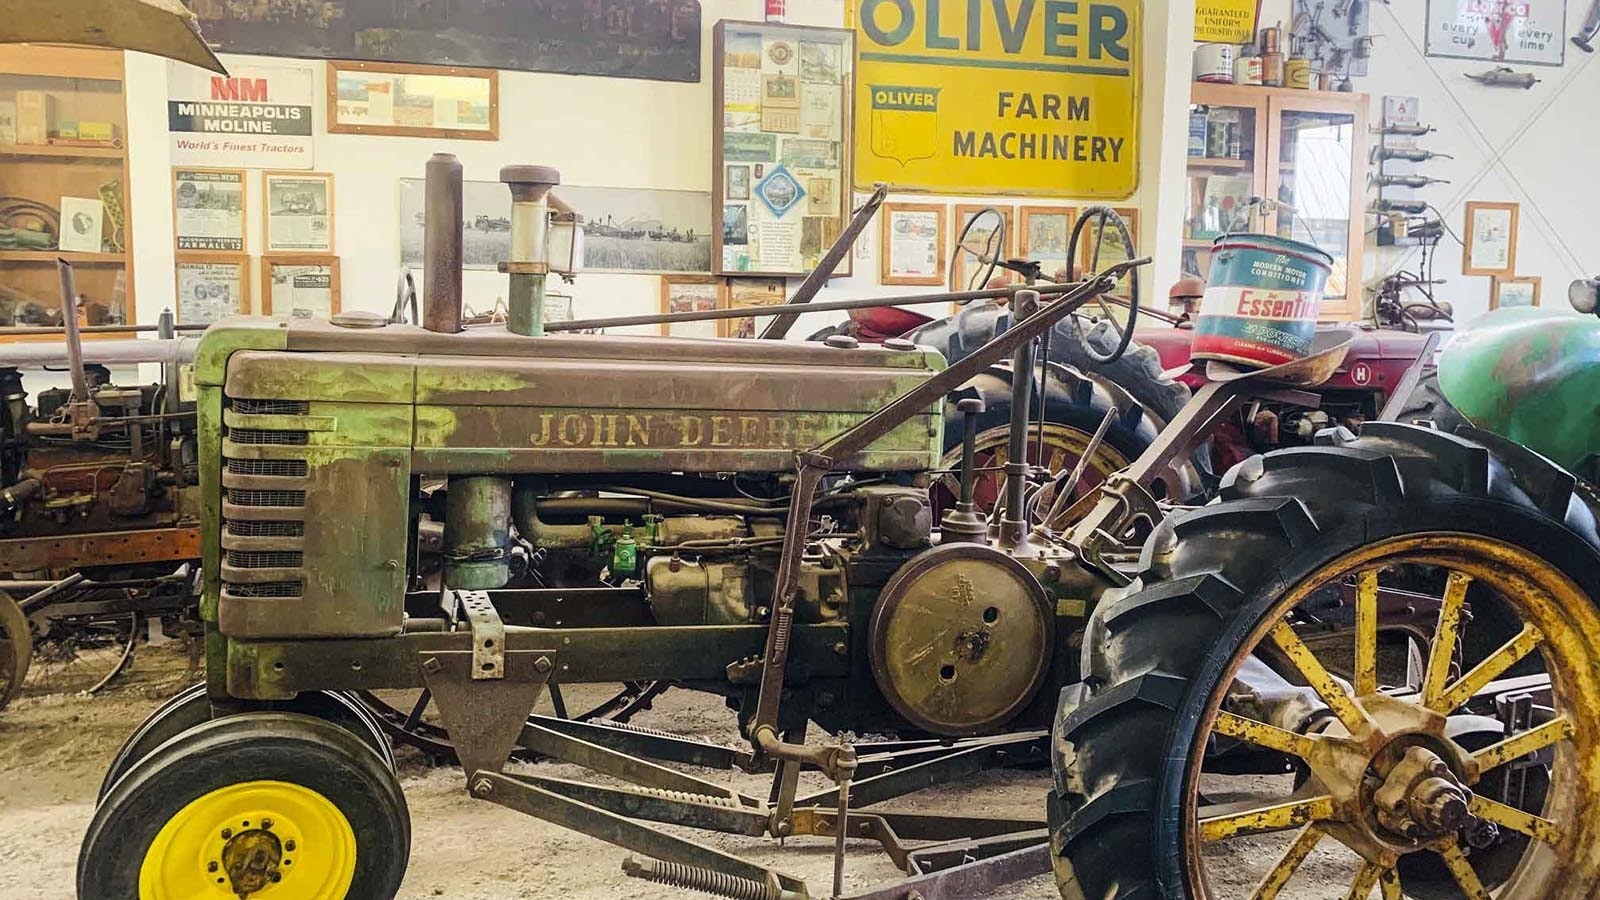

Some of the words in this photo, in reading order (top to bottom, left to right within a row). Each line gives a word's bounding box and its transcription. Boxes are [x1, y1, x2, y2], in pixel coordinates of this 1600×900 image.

[1196, 8, 1250, 19] GUARANTEED
[1204, 17, 1241, 28] UNIFORM
[1442, 22, 1479, 36] every
[860, 0, 1129, 62] OLIVER
[210, 76, 268, 102] MM
[875, 91, 935, 106] OLIVER
[178, 103, 301, 119] MINNEAPOLIS
[998, 92, 1090, 121] FARM
[177, 140, 219, 151] World's
[222, 141, 257, 151] Finest
[260, 143, 305, 153] Tractors
[954, 130, 1124, 163] MACHINERY
[179, 241, 226, 249] FARMALL
[1253, 261, 1284, 272] MODERN
[1285, 266, 1308, 279] MOTOR
[1357, 367, 1366, 381] H
[530, 413, 652, 446] JOHN
[679, 415, 817, 447] DEERE
